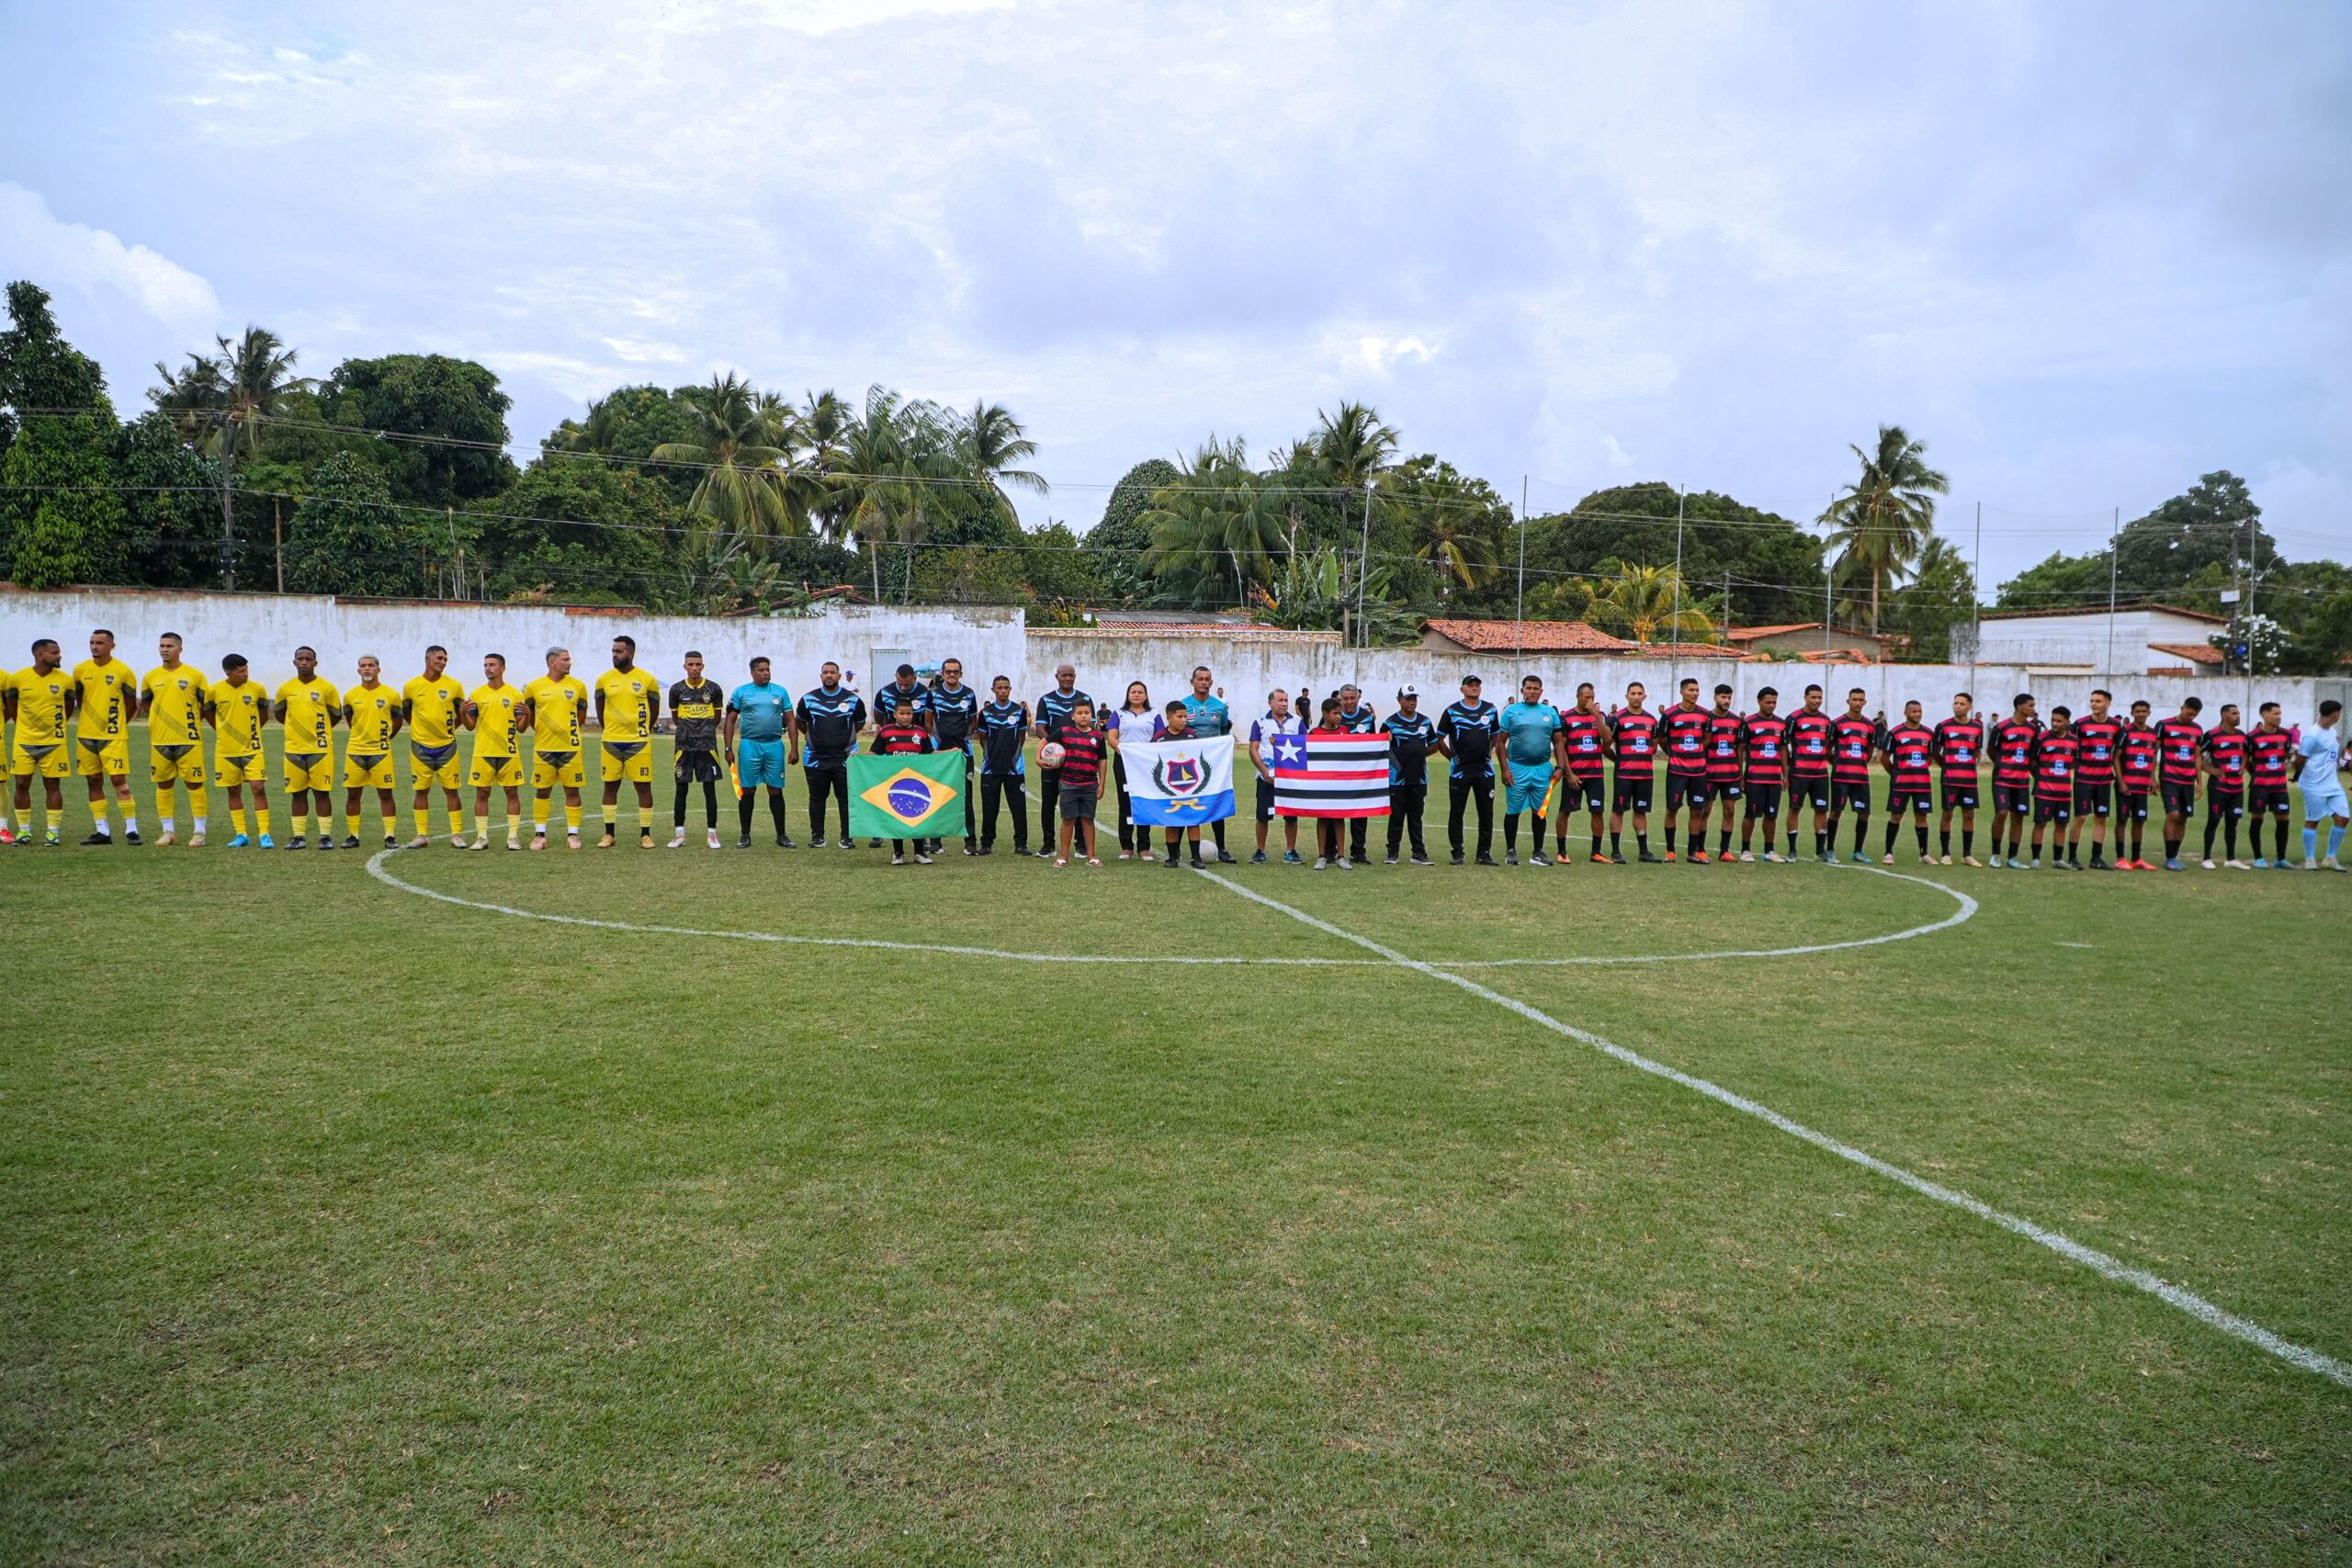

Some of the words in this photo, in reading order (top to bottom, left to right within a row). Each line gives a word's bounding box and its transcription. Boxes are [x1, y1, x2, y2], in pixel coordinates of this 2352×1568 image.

[54, 705, 64, 739] CABJ
[107, 697, 119, 734] CABJ
[316, 712, 328, 749] CABJ
[569, 711, 580, 747] CABJ
[638, 703, 649, 738] CABJ
[380, 720, 390, 750] CABJ
[507, 718, 517, 754] CABJ
[58, 763, 68, 772] 50
[113, 759, 123, 769] 73
[192, 767, 202, 777] 76
[383, 774, 392, 784] 65
[639, 767, 649, 777] 83
[712, 766, 717, 775] 1
